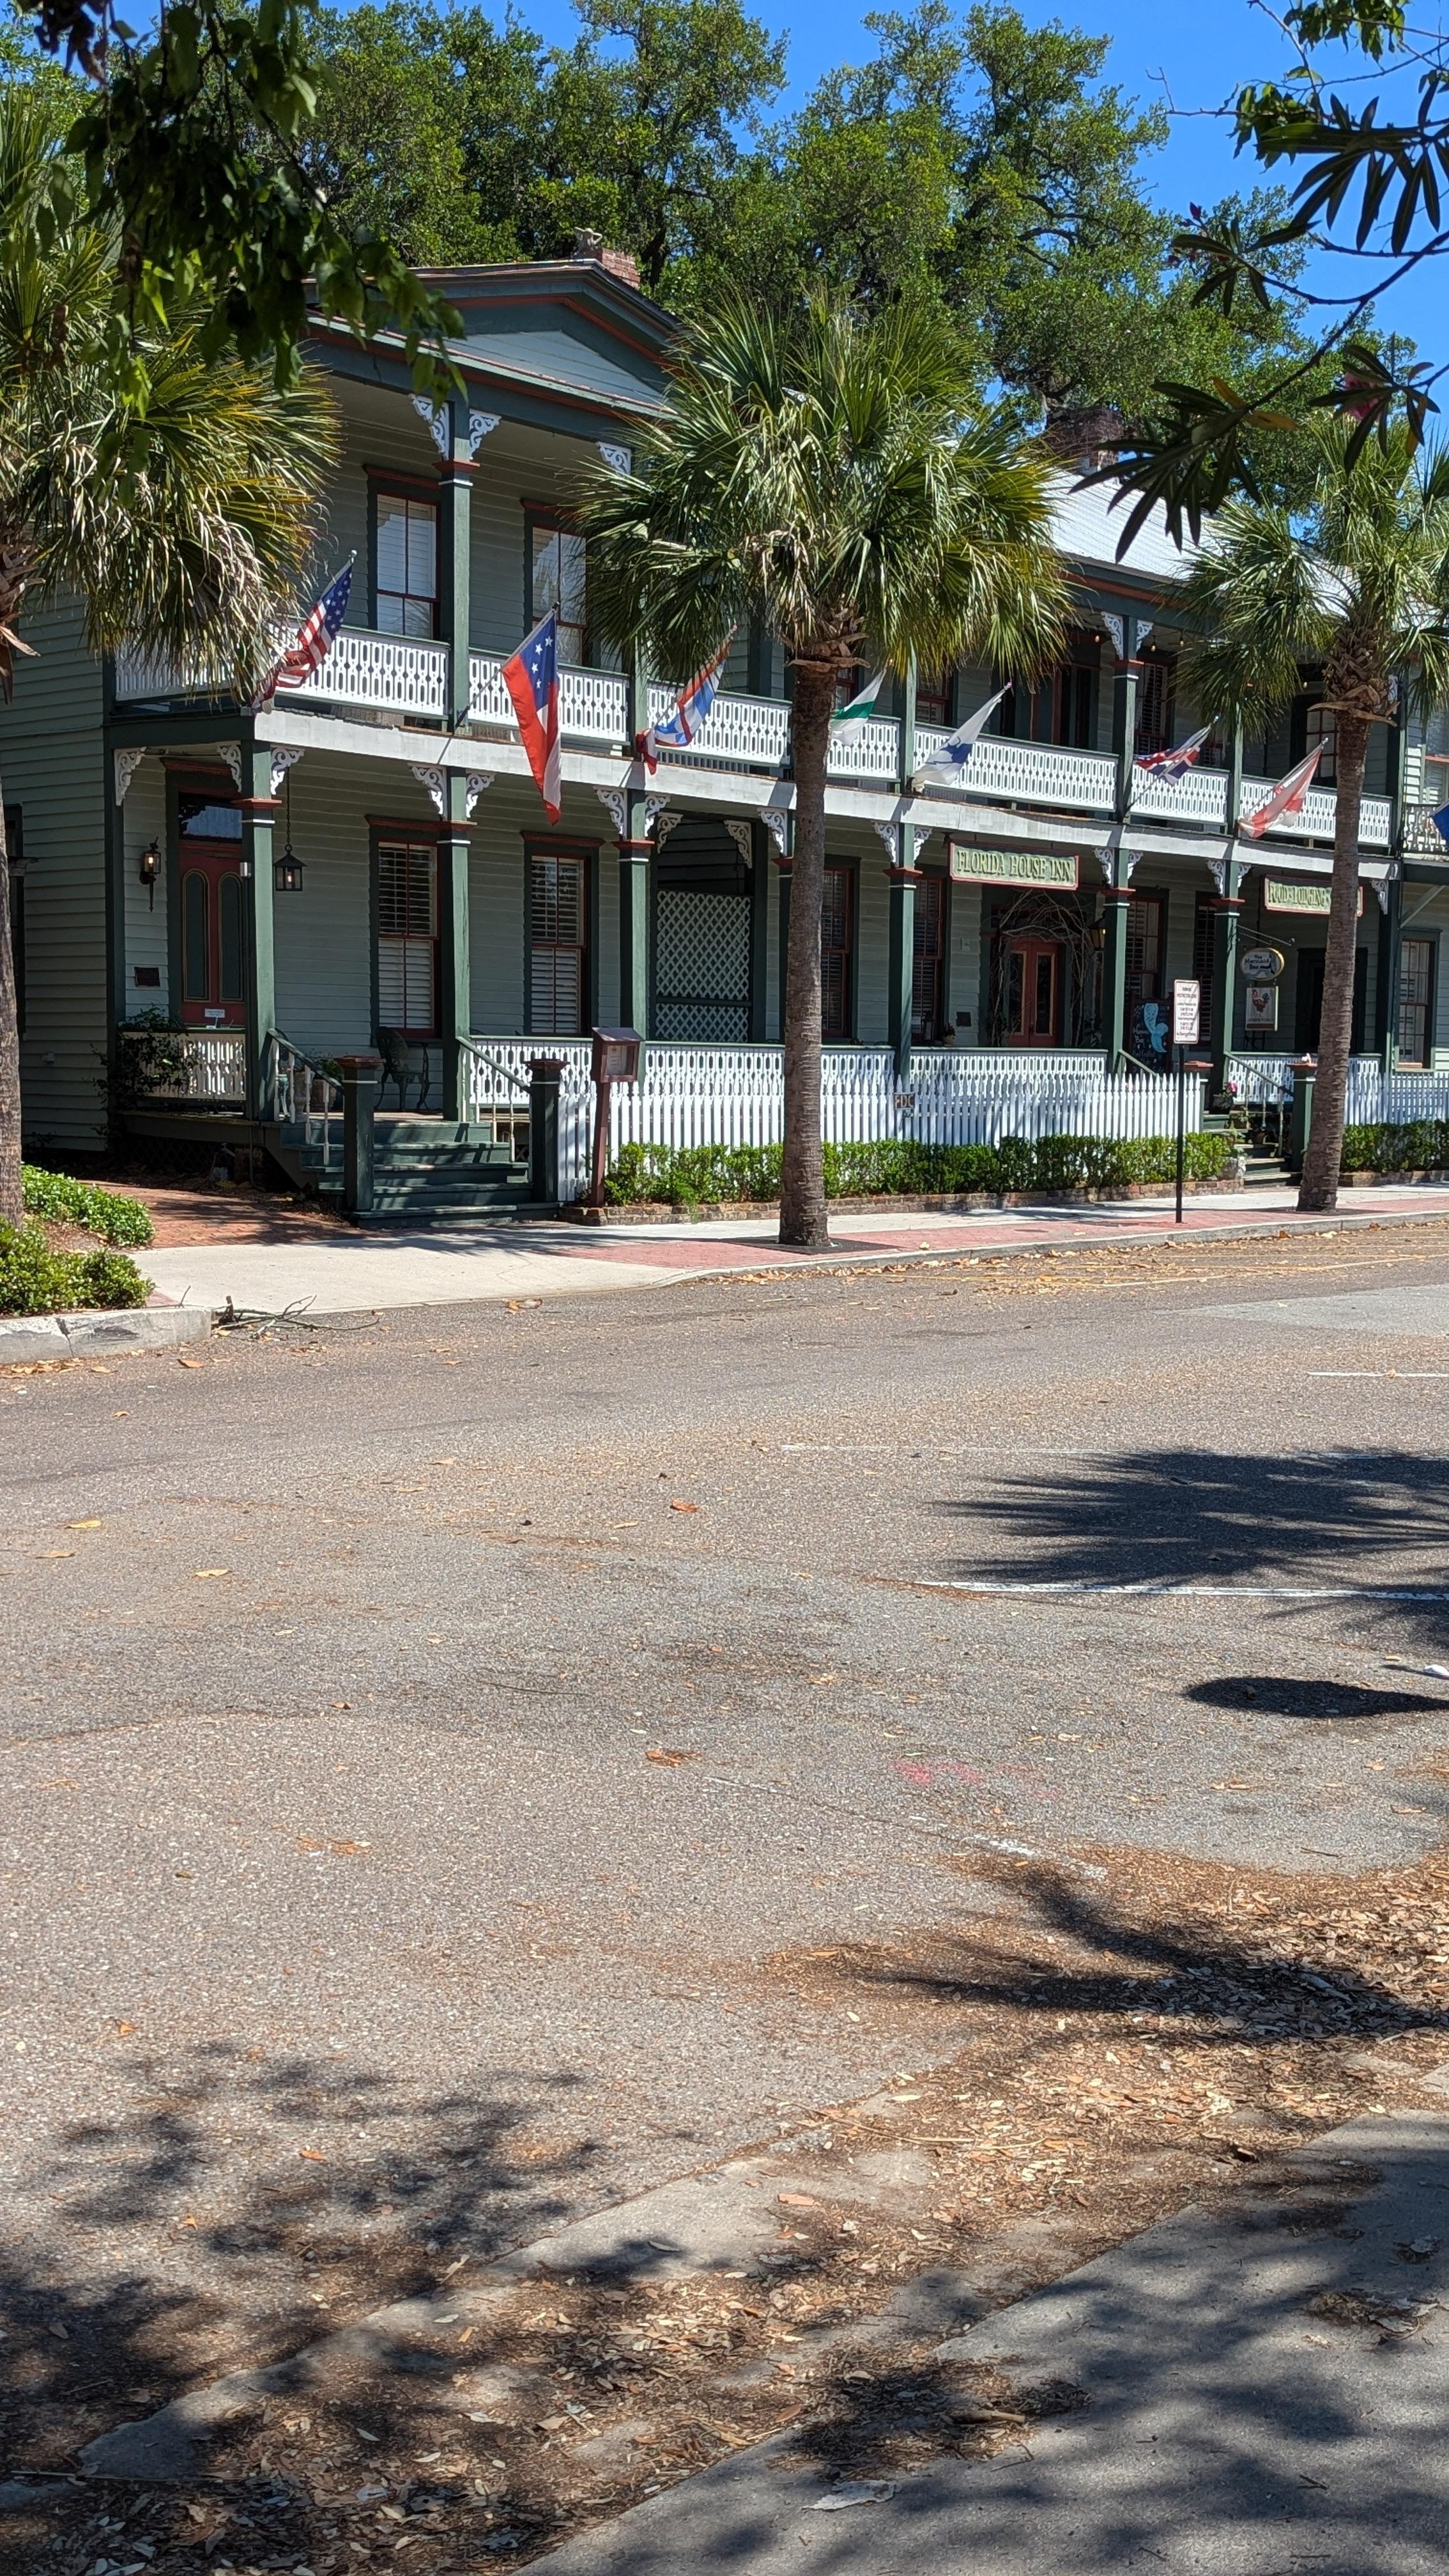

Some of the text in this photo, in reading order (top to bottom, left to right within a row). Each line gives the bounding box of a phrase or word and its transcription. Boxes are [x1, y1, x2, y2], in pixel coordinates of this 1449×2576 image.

[957, 850, 1071, 882] FLORIDA HOUSE INN
